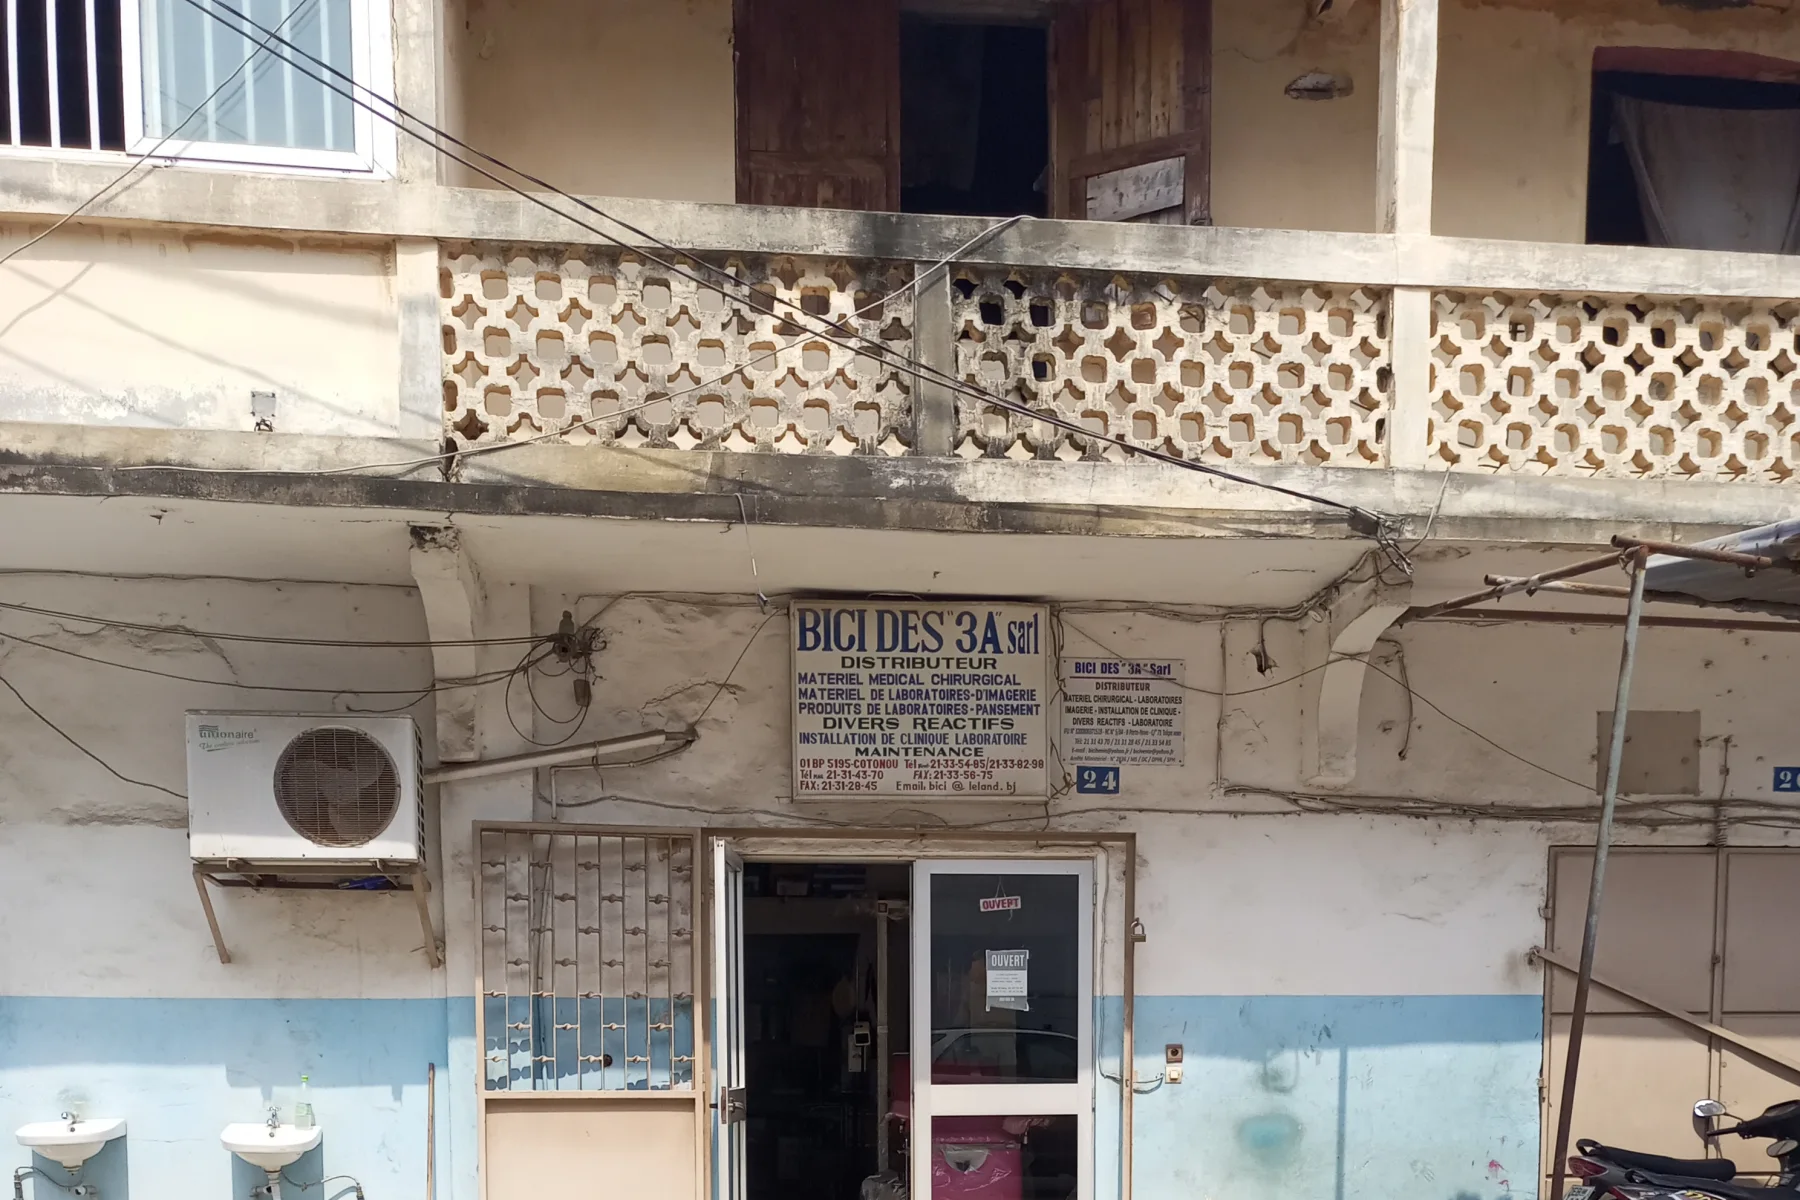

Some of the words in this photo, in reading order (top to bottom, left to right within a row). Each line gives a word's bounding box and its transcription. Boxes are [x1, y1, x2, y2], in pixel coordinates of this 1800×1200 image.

[797, 608, 867, 652] BICI
[875, 610, 944, 653] DES
[1008, 612, 1039, 655] sarl
[841, 656, 997, 669] DISTRIBUTEUR
[1075, 662, 1096, 673] BICI
[1101, 663, 1119, 674] DES
[1150, 663, 1171, 675] Sarl
[798, 672, 863, 685] MATERIEL
[869, 673, 924, 685] MEDICAL
[931, 673, 1021, 685] CHIRURGICAL
[1095, 682, 1150, 691] DISTRIBUTEUR
[798, 688, 865, 700] MATERIEL
[870, 689, 884, 700] DE
[1093, 695, 1133, 703] CHIRURGICAL
[1137, 696, 1182, 704] LABORATOIRES
[798, 703, 862, 715] PRODUITS
[867, 703, 881, 715] DE
[1065, 706, 1093, 714] IMAGERIE
[1098, 707, 1139, 715] INSTALLATION
[1140, 707, 1148, 715] DE
[1150, 707, 1177, 716] CLINIQUE
[823, 717, 899, 731] DIVERS
[913, 718, 1014, 731] REACTIFS
[1072, 717, 1094, 725] DIVERS
[1097, 718, 1125, 726] REACTIFS
[1132, 718, 1173, 727] LABORATOIRE
[799, 733, 876, 744] INSTALLATION
[881, 733, 895, 745] DE
[900, 733, 949, 746] CLINIQUE
[955, 733, 1027, 745] LABORATOIRE
[855, 747, 983, 756] MAINTENANCE
[826, 770, 884, 779] 21-31-43-70
[933, 770, 993, 780] 21-33-56-75
[1779, 770, 1800, 789] 2
[800, 781, 820, 790] FAX:
[821, 781, 878, 790] 21-31-28-45
[929, 781, 947, 791] bici
[982, 898, 1020, 910] OUVERT
[991, 954, 1024, 967] OUVERT
